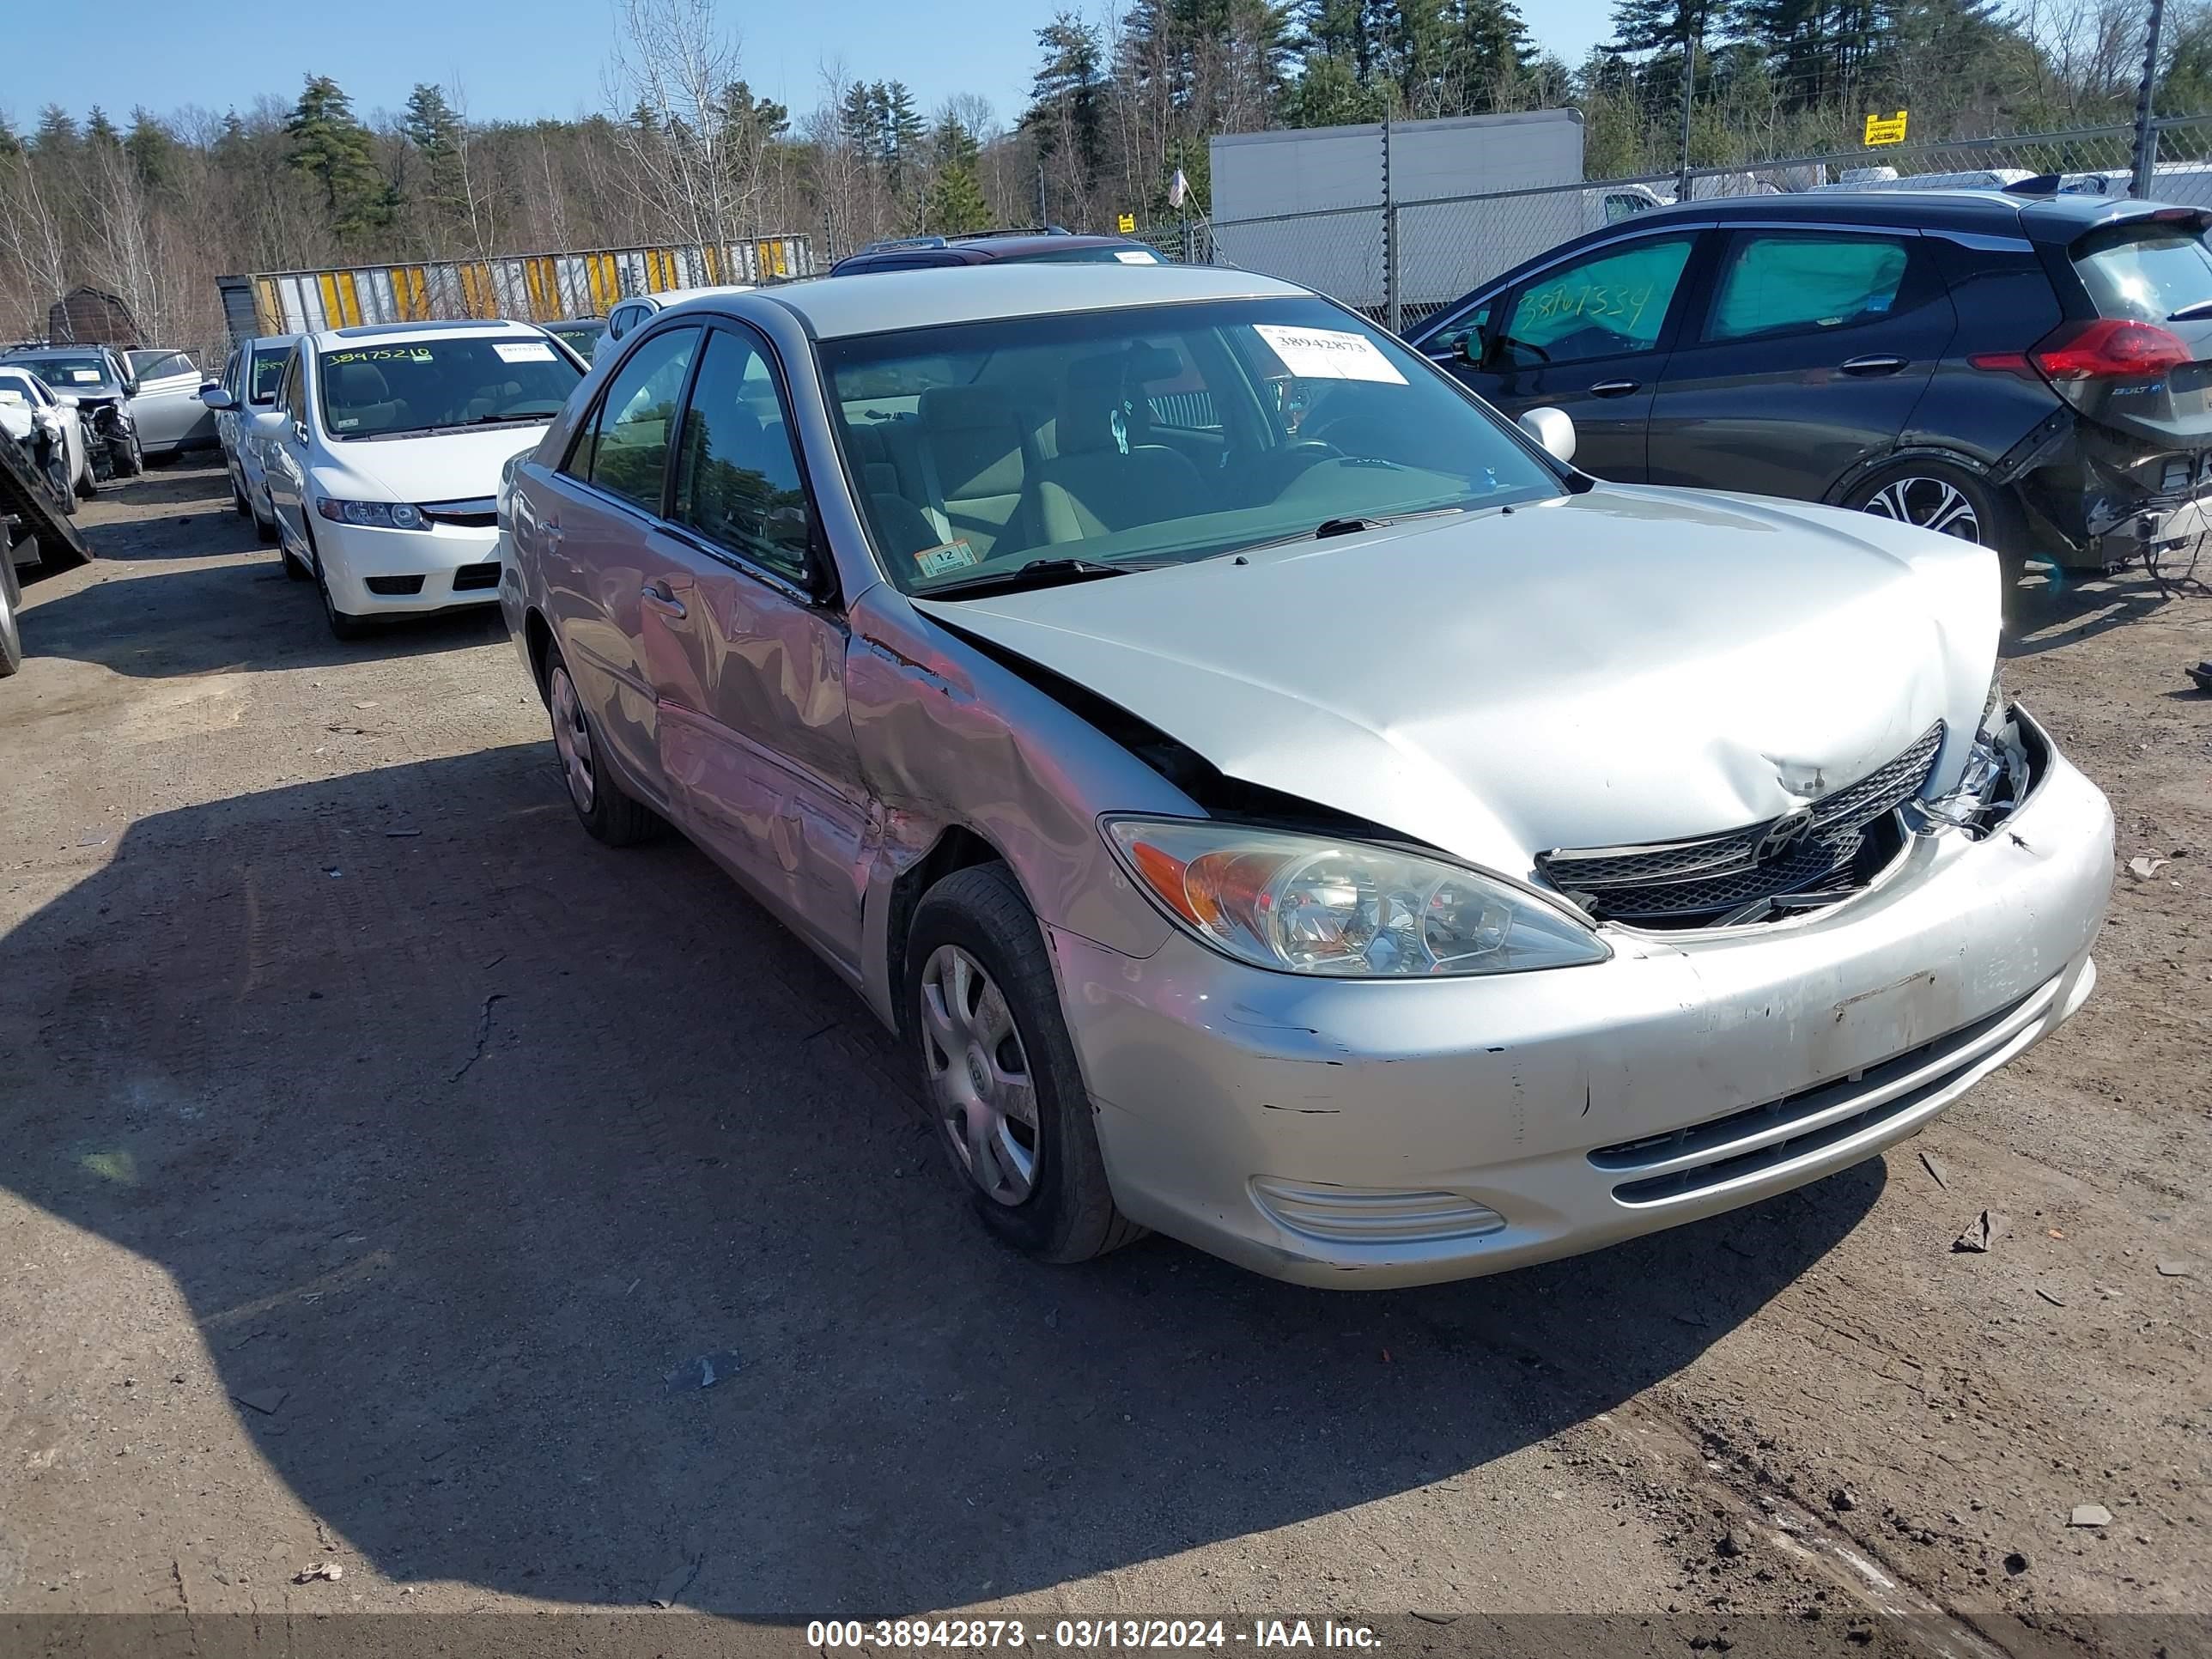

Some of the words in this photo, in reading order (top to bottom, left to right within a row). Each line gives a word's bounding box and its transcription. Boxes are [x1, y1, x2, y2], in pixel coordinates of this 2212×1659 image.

[1275, 336, 1367, 353] 38942873
[326, 347, 430, 367] 38975210
[936, 550, 956, 562] 12
